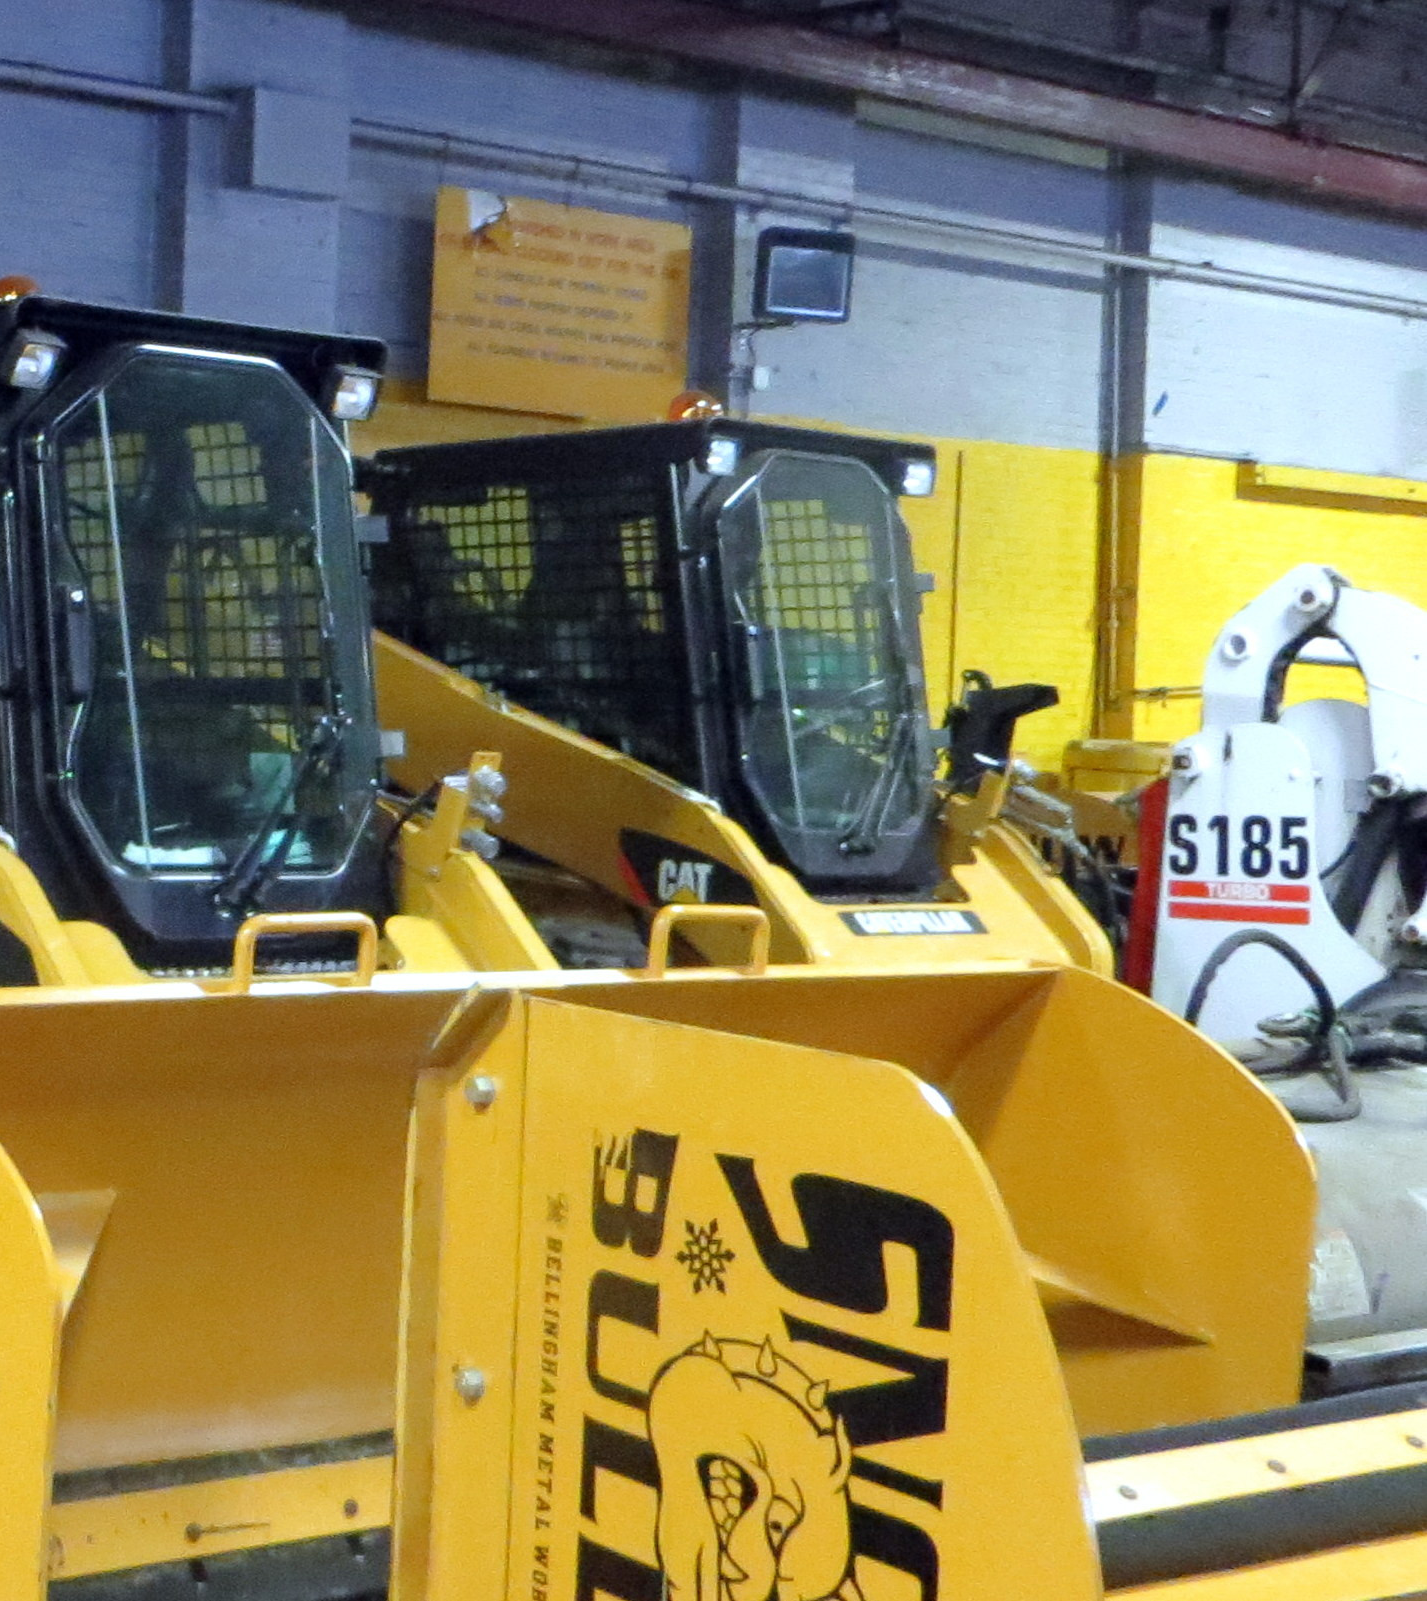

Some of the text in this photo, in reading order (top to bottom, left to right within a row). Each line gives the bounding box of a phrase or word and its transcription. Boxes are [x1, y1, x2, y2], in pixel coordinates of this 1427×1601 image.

[1168, 814, 1310, 880] S185
[657, 857, 714, 903] CAT
[1205, 881, 1271, 901] TURBO
[853, 910, 973, 935] CATERPILLAR
[538, 1235, 564, 1428] BELLINGHAM
[533, 1430, 558, 1532] METAL
